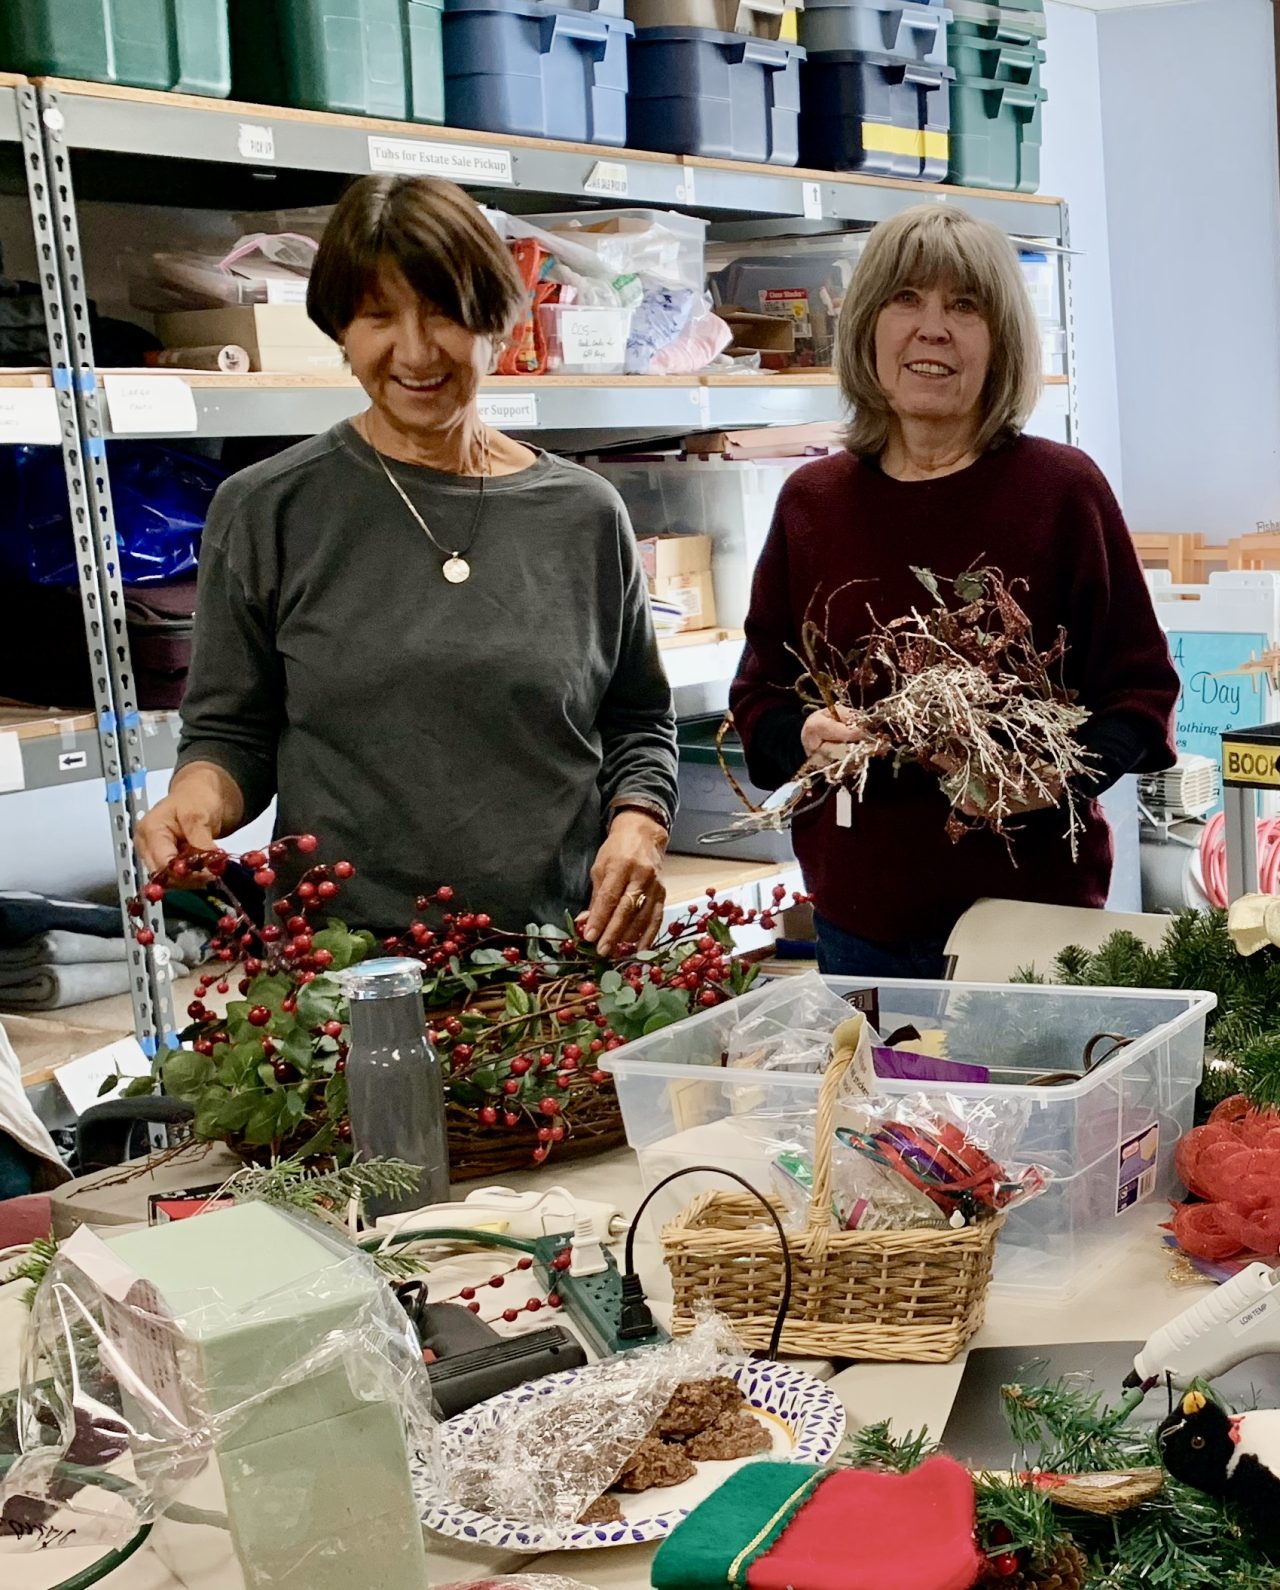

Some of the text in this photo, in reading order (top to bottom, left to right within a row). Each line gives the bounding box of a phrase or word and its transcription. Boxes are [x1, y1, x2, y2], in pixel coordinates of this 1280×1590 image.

[402, 150, 417, 162] for
[419, 152, 450, 165] Estate
[452, 156, 471, 167] Sale
[474, 157, 506, 173] Pickup
[491, 404, 530, 418] Support
[1172, 637, 1185, 668] A
[1189, 671, 1241, 715] Day
[1175, 721, 1219, 735] lothing
